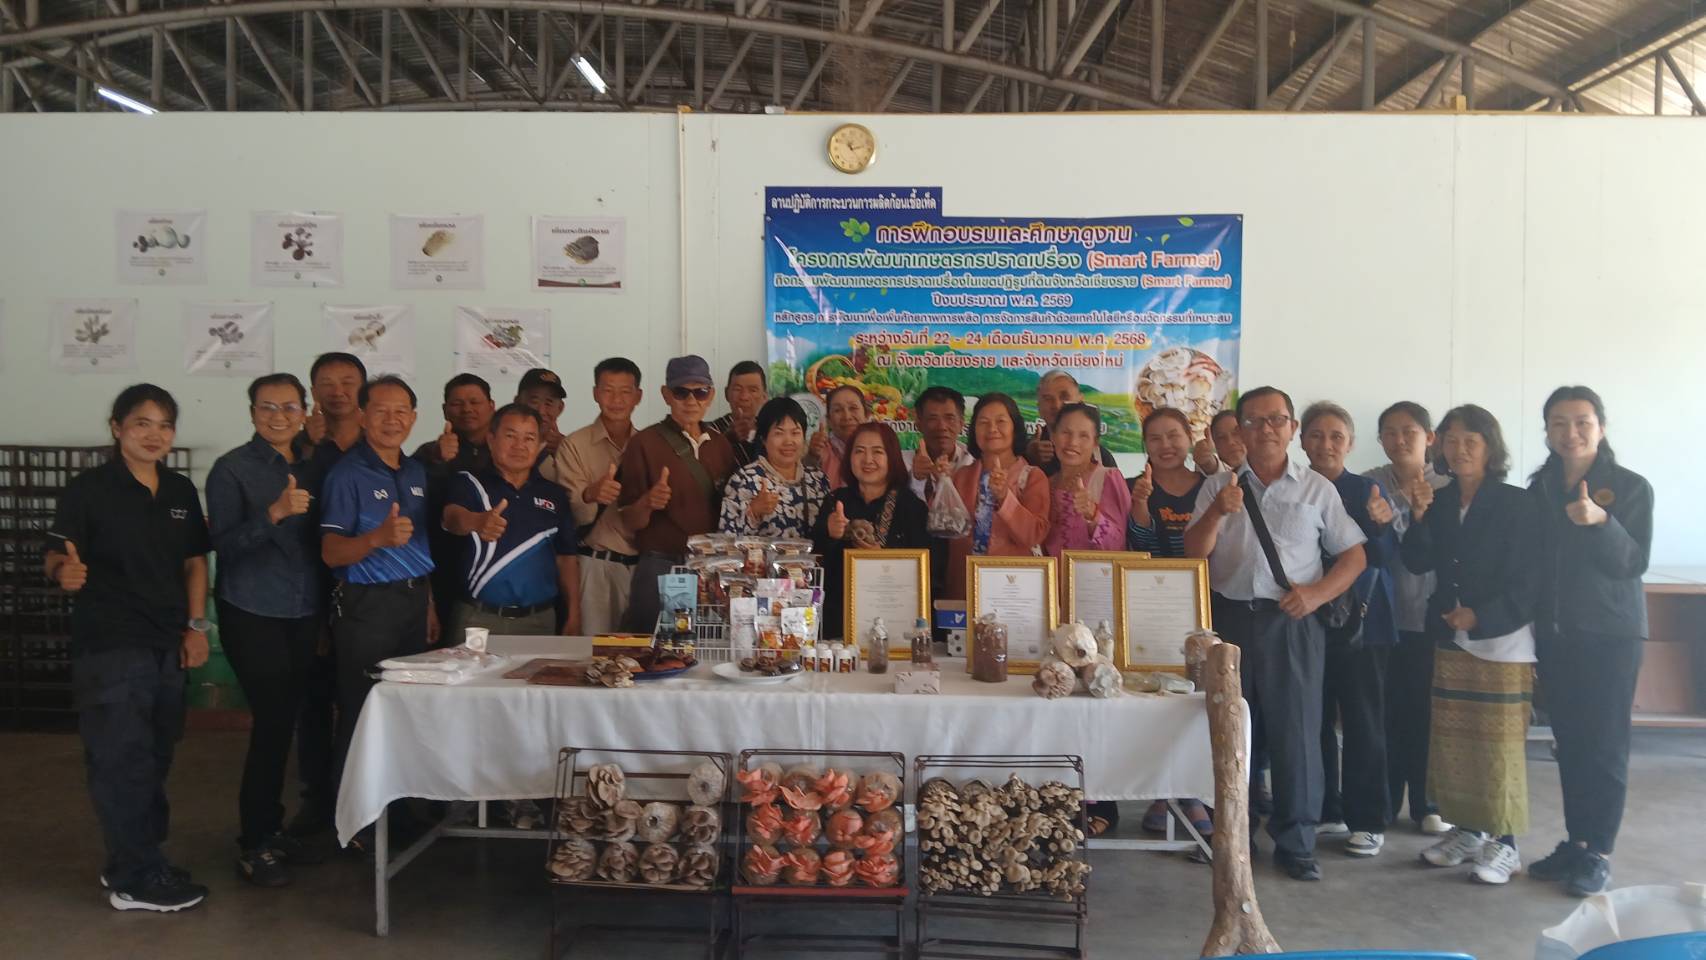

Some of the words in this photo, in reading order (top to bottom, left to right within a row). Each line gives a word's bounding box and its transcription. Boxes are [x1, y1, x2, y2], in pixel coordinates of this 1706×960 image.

[876, 221, 1132, 248] การฝึกอบรมและศึกษาดูงาน
[1087, 250, 1147, 271] (Smart
[1152, 249, 1221, 270] Farmer)
[774, 271, 1137, 292] กิจกรมพัฒนาเกษตรกรปราดเปรื่องในเขตปฏิรูปที่ดินจังหวัดเชียงราย
[1140, 274, 1181, 291] (Smart
[1183, 273, 1233, 290] Farmer)
[932, 291, 1006, 307] ปีงบประมาณ
[1010, 294, 1037, 308] พ.ศ.
[1041, 294, 1073, 308] 2569
[774, 310, 815, 326] หลักสูตร
[854, 328, 929, 347] ระหว่างวันที่
[932, 331, 951, 346] 22
[965, 331, 983, 346] 24
[988, 329, 1073, 346] เดือนธันวาคม
[1079, 331, 1108, 346] พ.ศ.
[1114, 331, 1146, 346] 2568
[876, 355, 892, 368] ณ
[895, 352, 997, 369] จังหวัดเชียงราย
[1002, 352, 1124, 369] และจังหวัดเชียงใหม่
